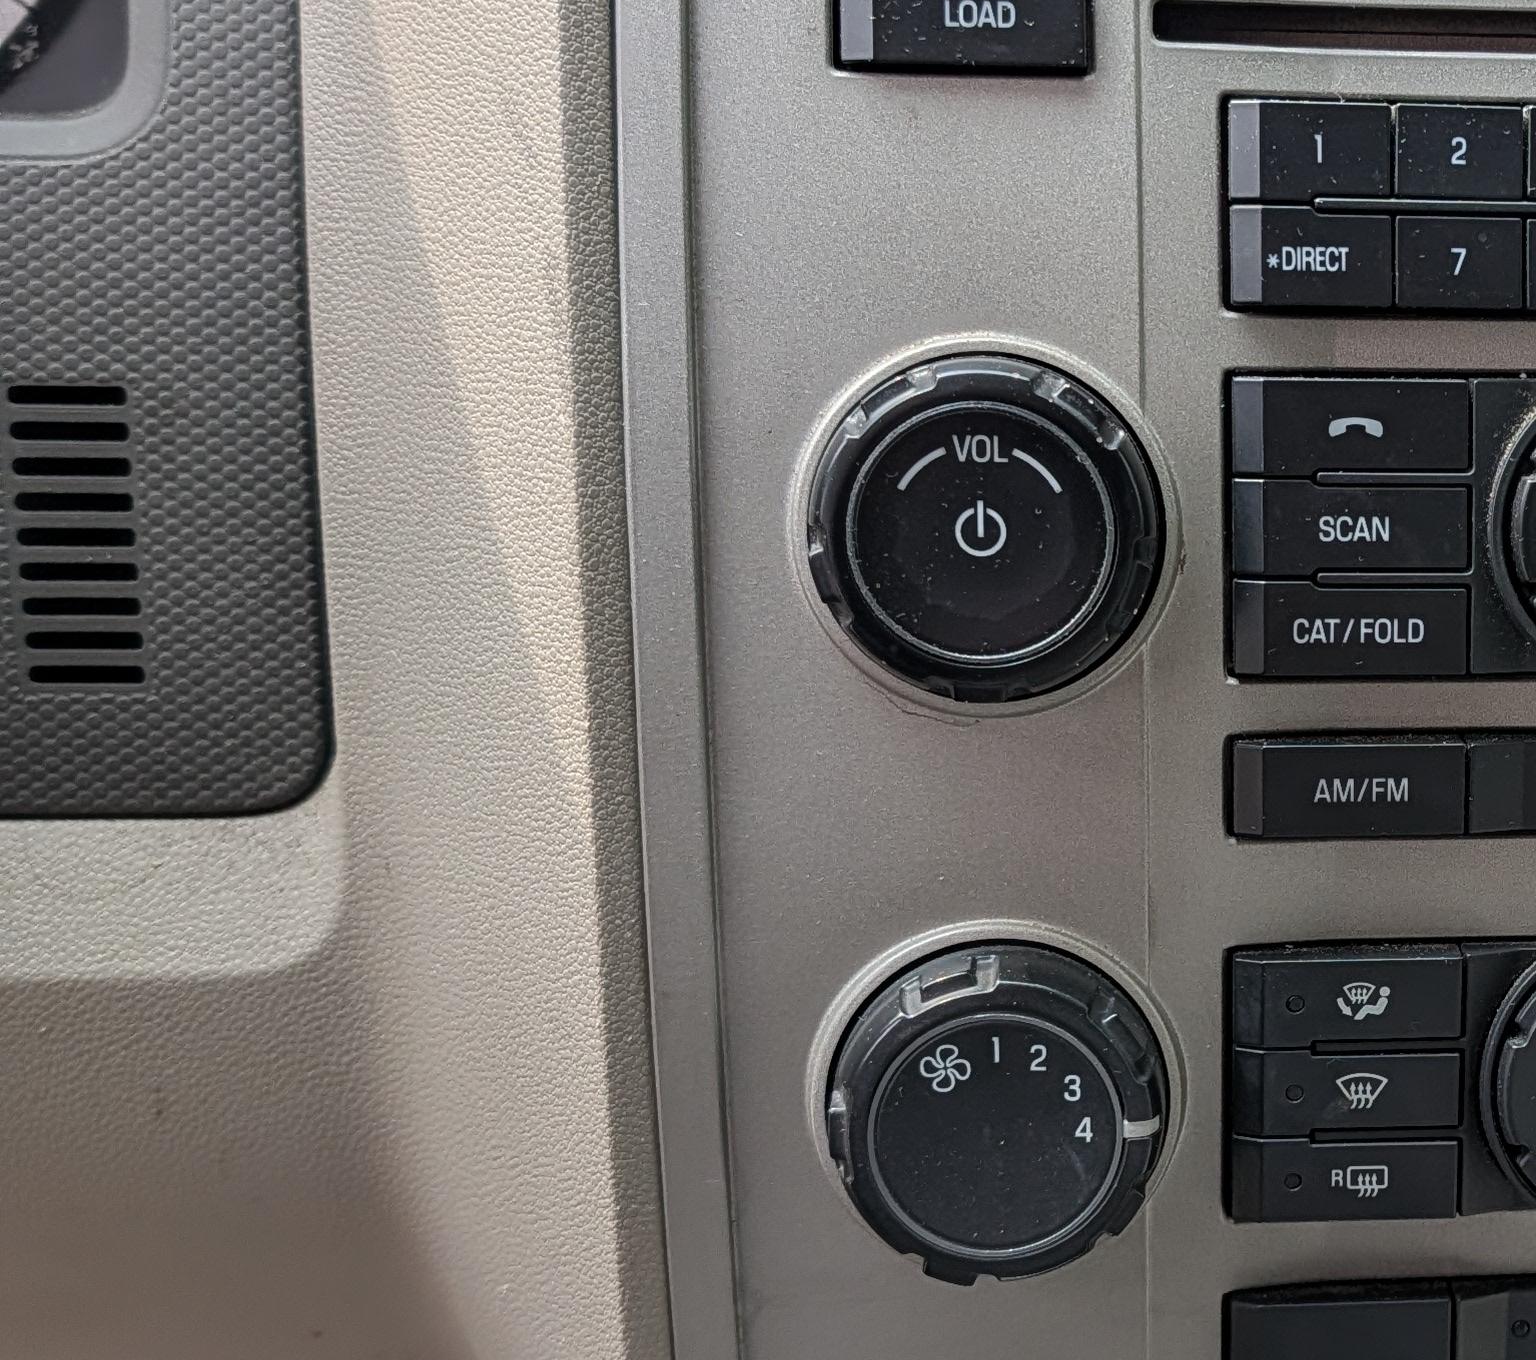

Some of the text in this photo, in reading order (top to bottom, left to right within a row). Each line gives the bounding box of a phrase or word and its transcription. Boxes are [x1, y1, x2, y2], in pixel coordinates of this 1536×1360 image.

[944, 0, 1016, 29] LOAD
[1450, 136, 1467, 165] 2
[1450, 247, 1467, 276] 7
[952, 434, 1009, 463] VOL
[1318, 515, 1390, 542] SCAN
[1293, 617, 1425, 644] CAT/FOLD
[1313, 777, 1409, 803] AM/FM
[1029, 1044, 1047, 1072] 2
[1063, 1074, 1081, 1102] 3
[1074, 1116, 1094, 1143] 4
[1331, 1169, 1344, 1187] R
